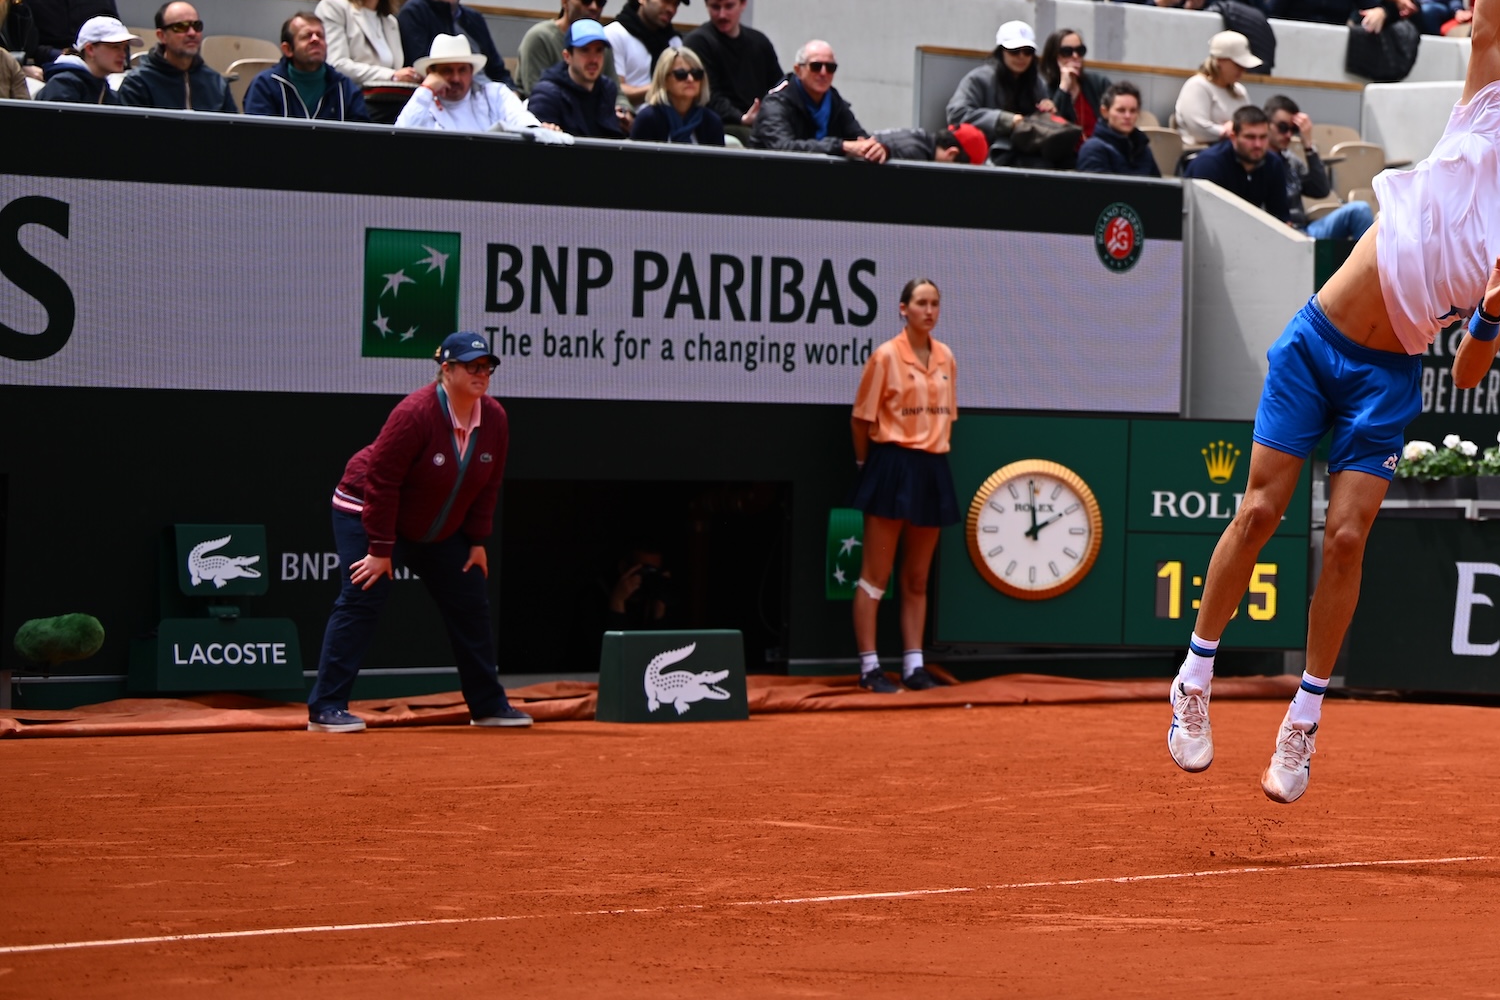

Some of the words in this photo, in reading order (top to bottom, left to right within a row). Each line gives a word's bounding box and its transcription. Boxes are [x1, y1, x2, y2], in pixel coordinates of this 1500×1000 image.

[484, 243, 614, 316] BNP
[631, 249, 879, 328] PARIBAS
[485, 326, 532, 356] The
[543, 327, 605, 358] bank
[612, 329, 651, 366] for
[661, 340, 675, 360] a
[684, 333, 796, 372] changing
[804, 338, 872, 365] world
[1150, 491, 1286, 520] ROL
[281, 552, 340, 580] BNP
[1157, 560, 1278, 620] 1:5
[173, 643, 287, 664] LACOSTE
